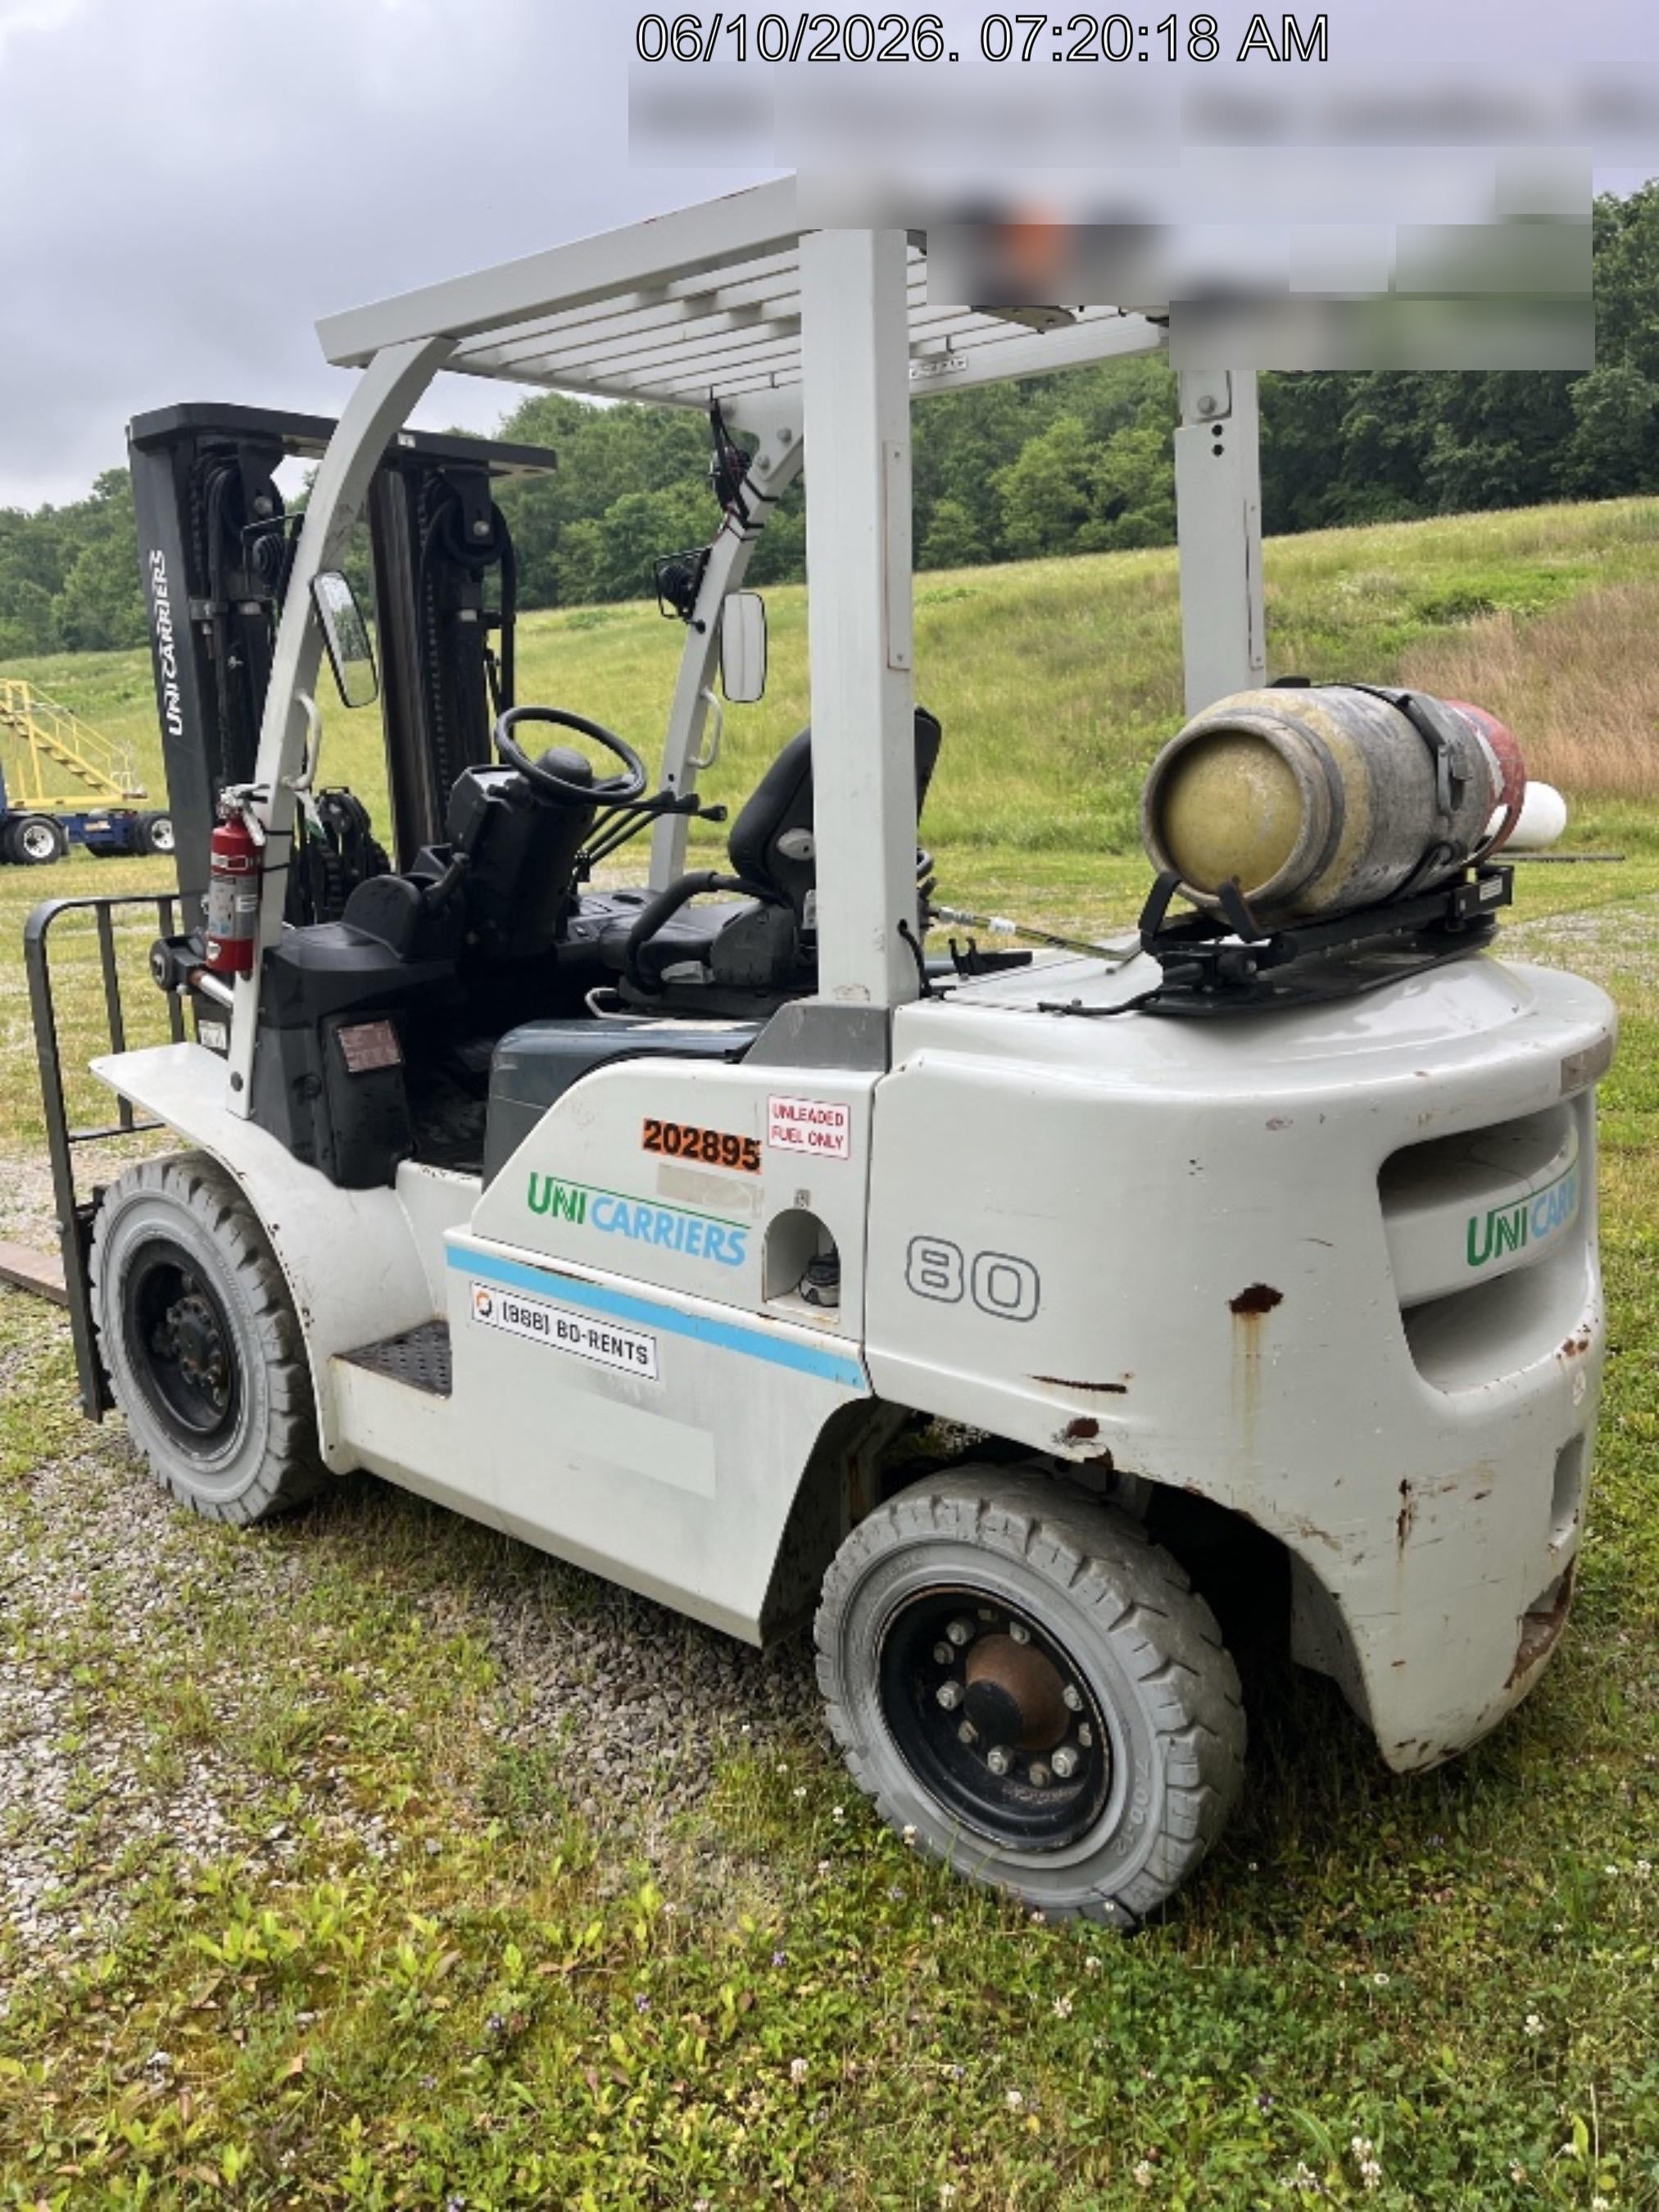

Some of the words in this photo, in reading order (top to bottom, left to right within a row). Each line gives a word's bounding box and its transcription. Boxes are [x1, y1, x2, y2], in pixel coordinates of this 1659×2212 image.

[773, 1103, 844, 1126] UNLEADED
[643, 1117, 761, 1172] 202895
[771, 1125, 805, 1145] FUEL
[808, 1131, 844, 1149] ONLY
[904, 1235, 1040, 1322] 80
